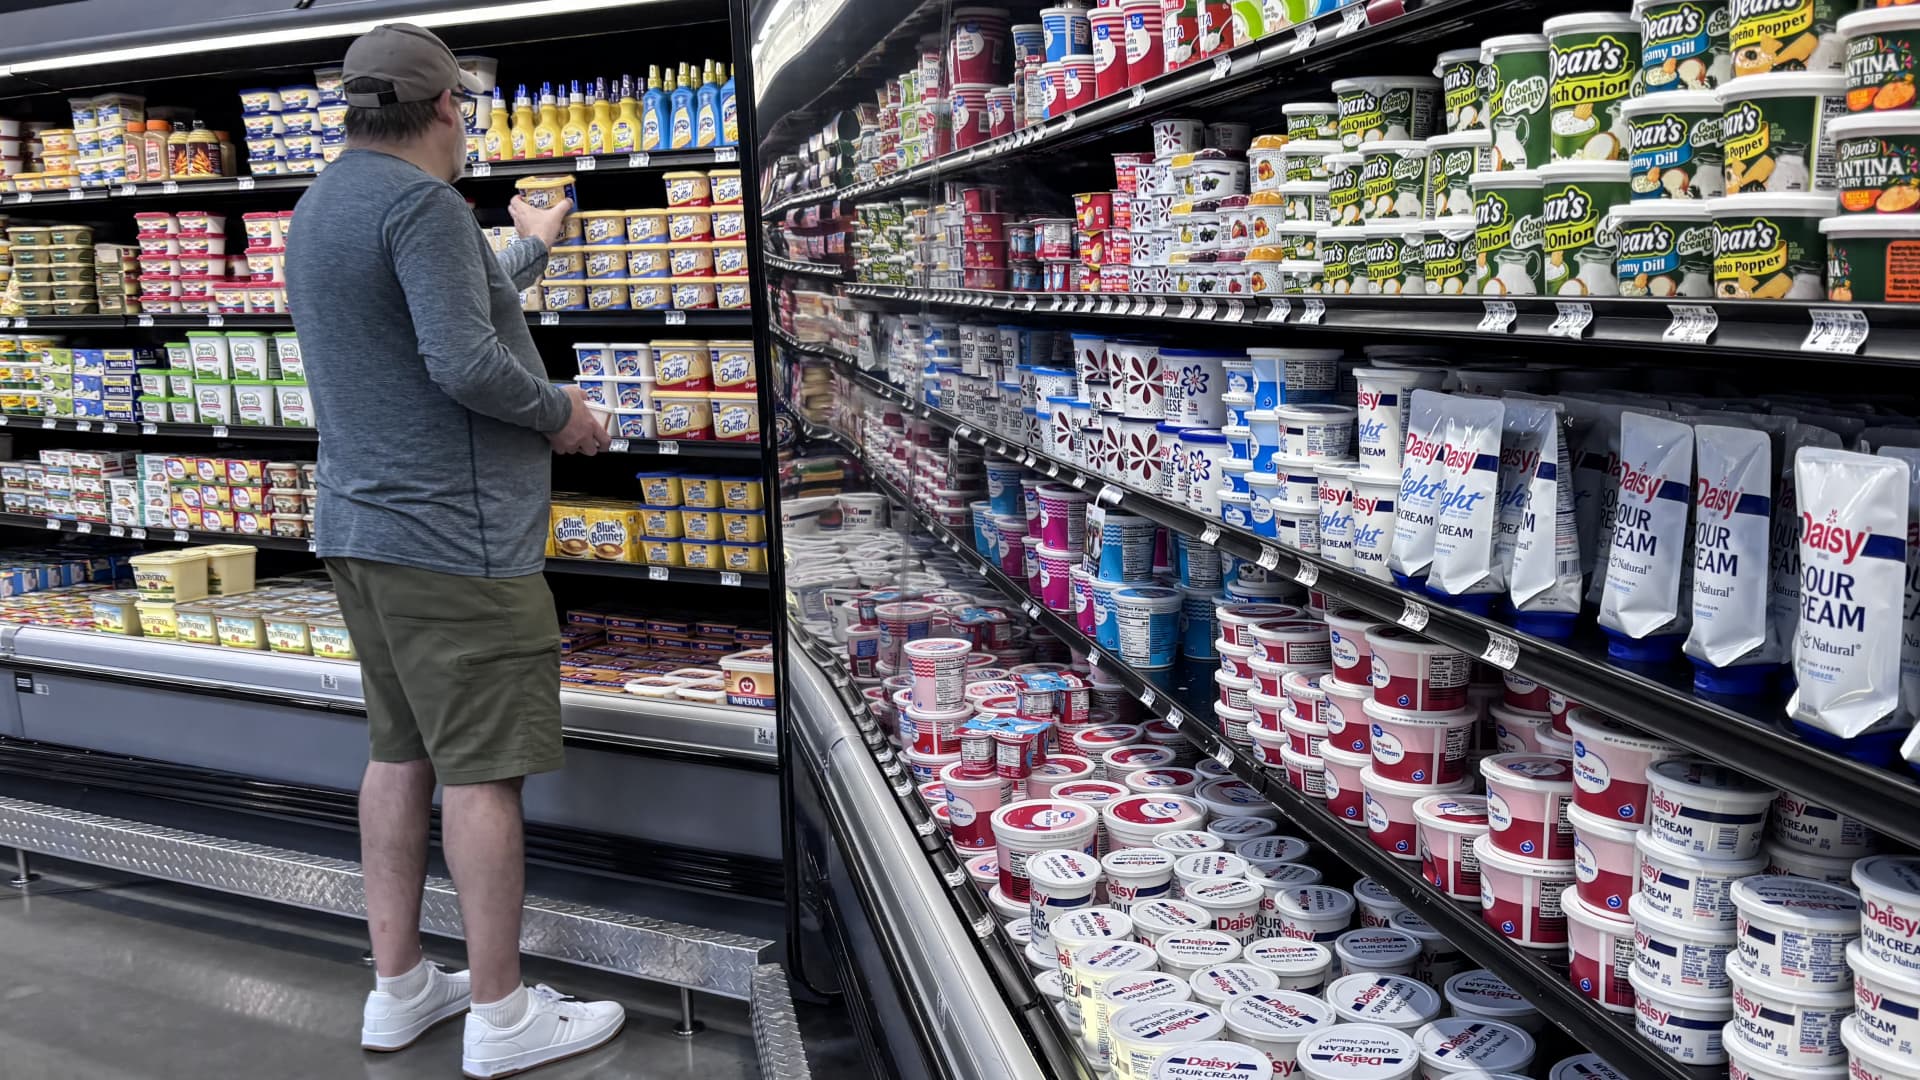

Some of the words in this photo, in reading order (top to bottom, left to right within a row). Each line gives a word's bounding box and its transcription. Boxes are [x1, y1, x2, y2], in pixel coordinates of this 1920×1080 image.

[1757, 13, 1807, 37] Popper
[1643, 48, 1668, 63] eamy
[1671, 41, 1695, 57] Dill
[1847, 53, 1899, 73] NTINA
[1863, 73, 1884, 86] DIP
[1449, 90, 1477, 107] Onion
[1571, 79, 1630, 101] Onion
[1505, 87, 1545, 112] Creamy
[1351, 114, 1382, 129] Onion
[1730, 138, 1763, 158] Popper
[1841, 138, 1877, 158] Dean's
[1364, 155, 1390, 180] an's
[1631, 156, 1653, 170] eamy
[1655, 150, 1678, 166] Dill
[1369, 179, 1394, 196] Onion
[1864, 174, 1888, 187] DIP
[1335, 189, 1359, 205] Onion
[1477, 229, 1510, 251] Onion
[1550, 226, 1594, 249] Onion
[1327, 264, 1350, 280] Onion
[1373, 263, 1400, 278] Onion
[1432, 261, 1463, 276] Onion
[1618, 262, 1639, 276] eamy
[1642, 257, 1665, 272] Dill
[1735, 254, 1781, 274] Popper
[1164, 386, 1185, 399] TTAGE
[563, 517, 582, 529] Blue
[1401, 510, 1433, 526] CREAM
[558, 526, 587, 538] Bonne
[596, 522, 616, 534] Blue
[1438, 524, 1473, 539] CREAM
[591, 532, 624, 545] Bonnet
[1328, 538, 1352, 549] CREAM
[1801, 511, 1866, 565] Daisy
[1357, 550, 1382, 561] CREAM
[1801, 598, 1865, 632] REAM
[732, 696, 766, 707] IMPERIAL
[758, 728, 767, 739] 34
[1582, 770, 1605, 786] Cream
[1659, 818, 1693, 837] CREAM
[1783, 818, 1818, 836] CREAM
[1217, 912, 1257, 932] Daisy
[1868, 899, 1918, 938] Daisy
[1181, 938, 1216, 946] Daisy
[1360, 936, 1392, 944] Daisy
[1886, 937, 1920, 956] CREA
[1121, 979, 1155, 995] Daisy
[1145, 983, 1176, 996] CREAM
[1355, 983, 1387, 1005] Daisy
[1385, 982, 1406, 1004] CREAM
[1243, 999, 1269, 1015] SOUR
[1268, 1011, 1303, 1029] CREAM
[1266, 998, 1305, 1018] Daisy
[1159, 1017, 1200, 1036] Daisy
[1740, 1016, 1775, 1040] CREAM
[1861, 1007, 1897, 1035] CREAM
[1440, 1029, 1475, 1050] Daisy
[1473, 1030, 1501, 1049] CREAM
[1646, 1024, 1682, 1045] CREAM
[1318, 1044, 1362, 1053] CREAM
[1363, 1046, 1399, 1054] SOUR
[1187, 1056, 1237, 1071] Daisy
[1333, 1054, 1382, 1067] Daisy
[1168, 1067, 1203, 1078] SOUR
[1205, 1070, 1249, 1080] CREAM
